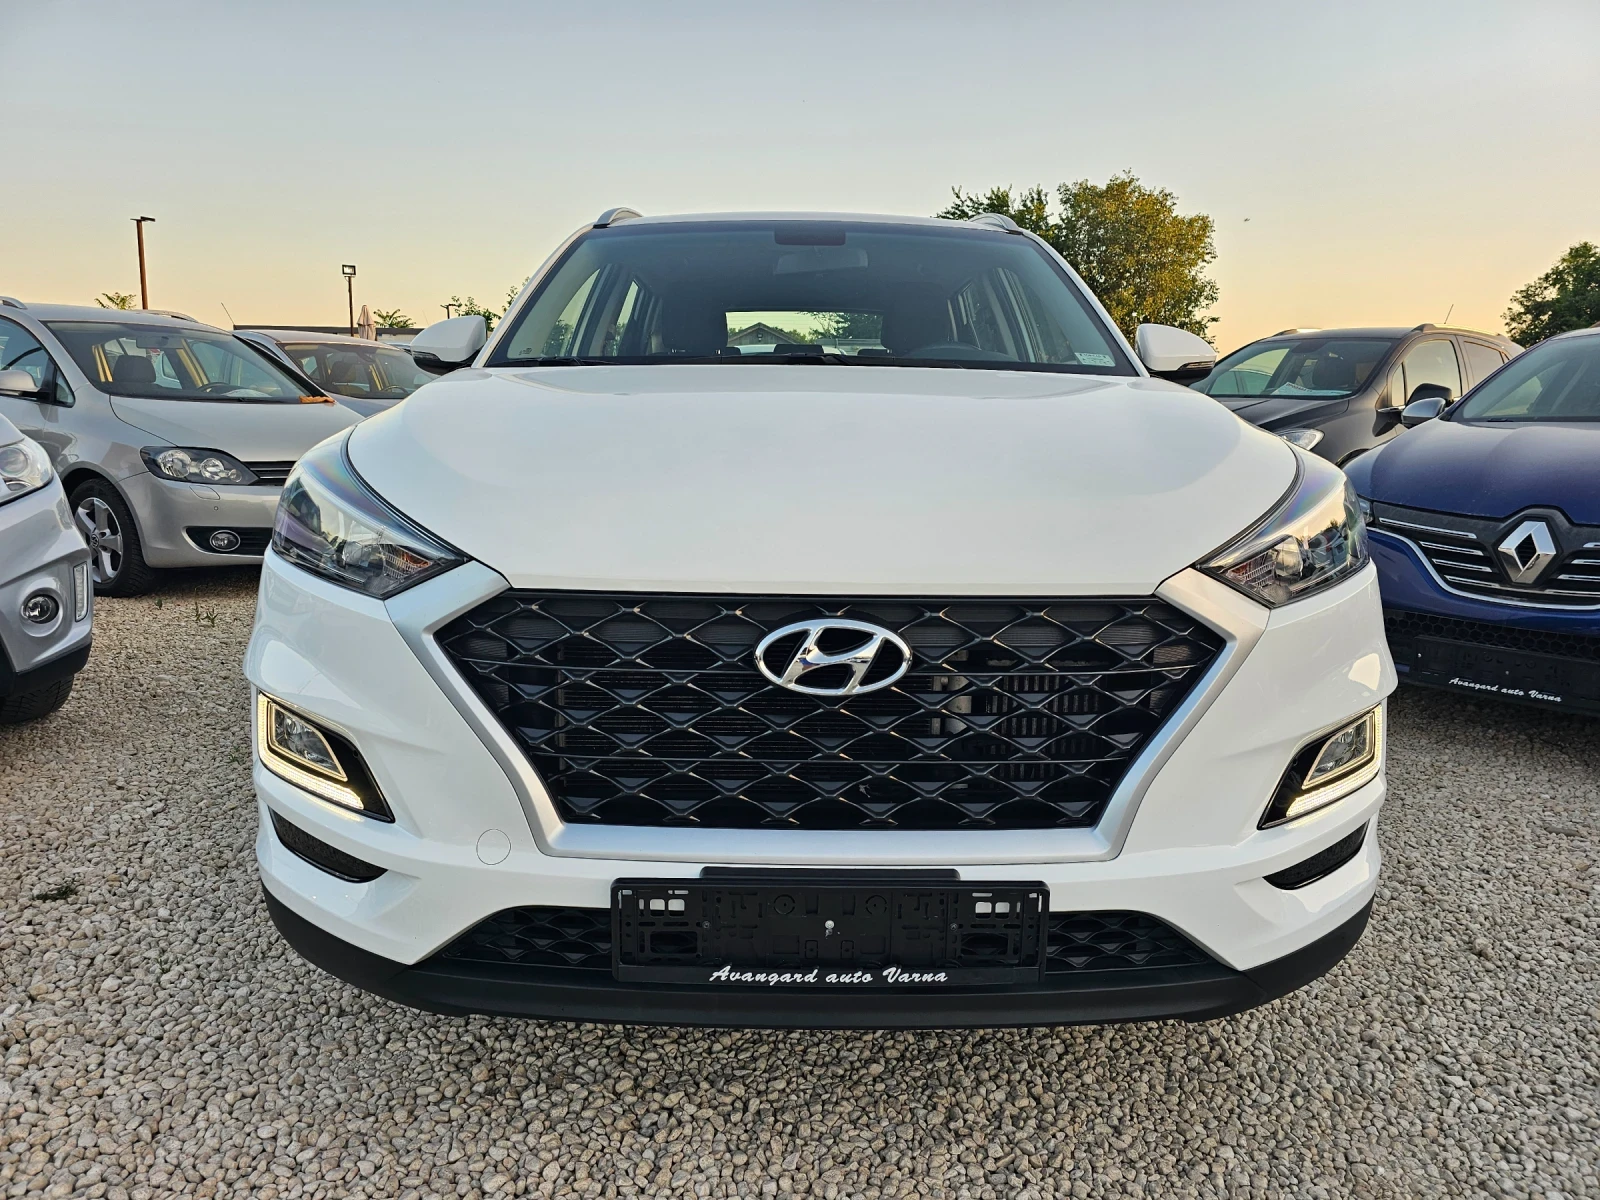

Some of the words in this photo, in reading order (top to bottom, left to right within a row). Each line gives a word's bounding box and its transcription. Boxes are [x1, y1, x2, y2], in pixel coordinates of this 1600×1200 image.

[1448, 677, 1499, 692] Avangard
[1500, 687, 1525, 696] auto
[1528, 689, 1562, 702] Varna
[708, 965, 819, 986] Avangard
[825, 970, 874, 984] auto
[882, 966, 949, 984] Varna
